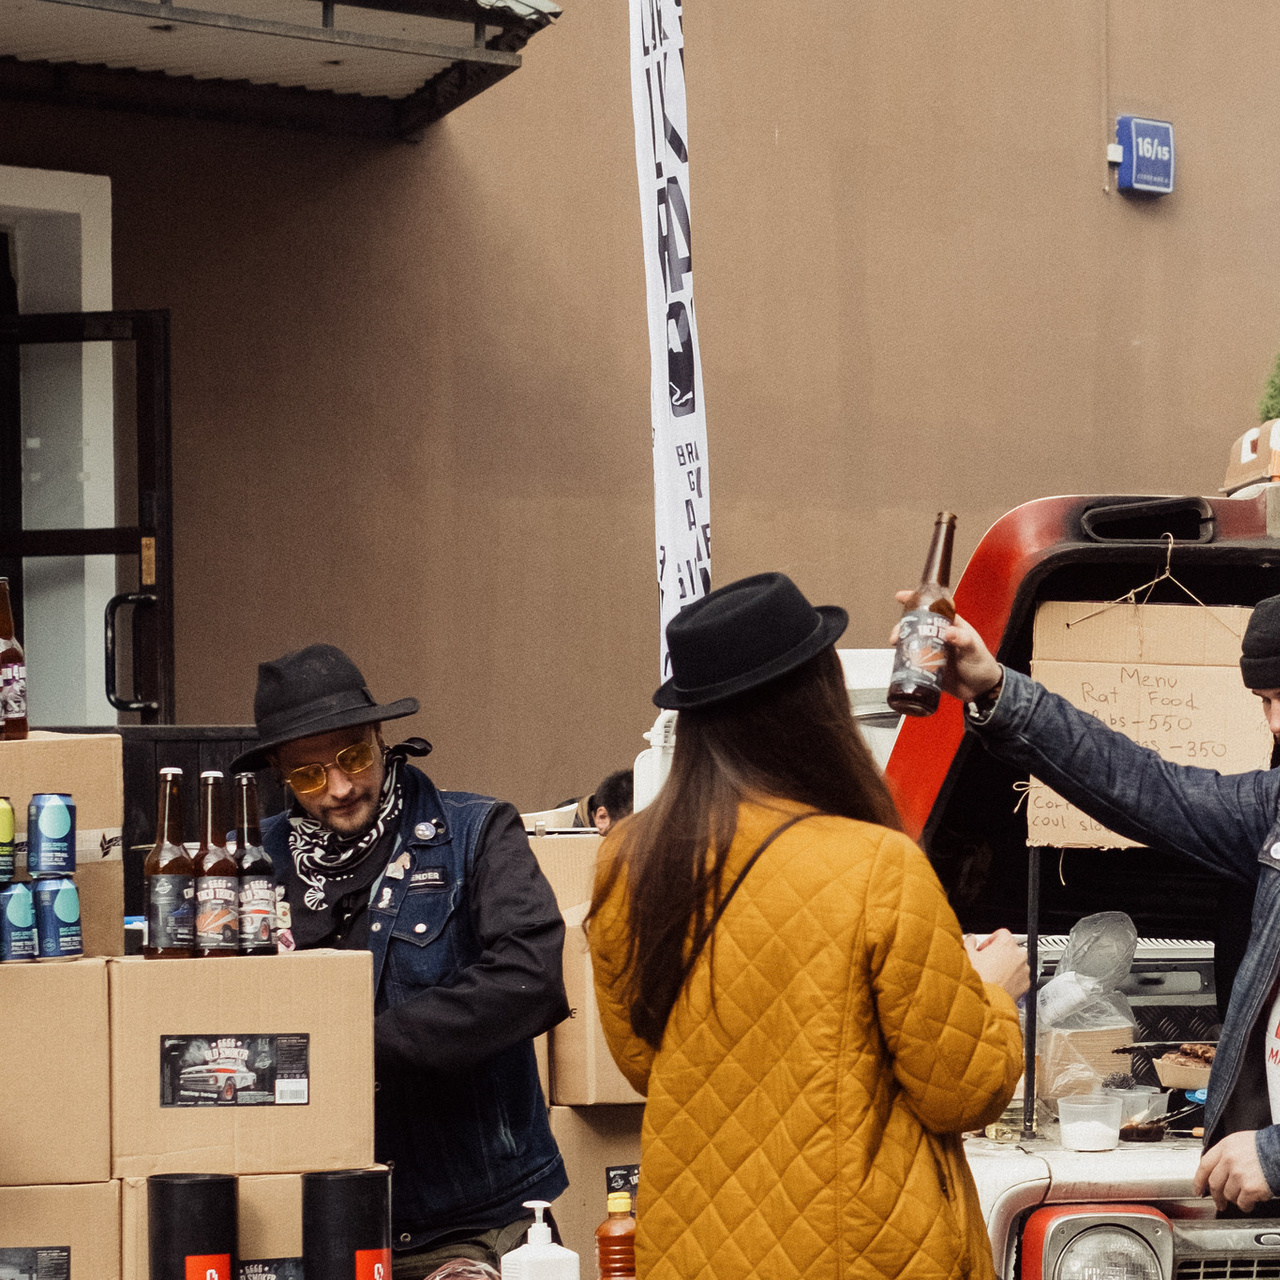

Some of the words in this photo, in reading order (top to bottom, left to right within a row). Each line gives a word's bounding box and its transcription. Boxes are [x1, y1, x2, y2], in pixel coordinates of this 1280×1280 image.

[1137, 137, 1170, 161] 16/15
[1120, 667, 1178, 689] Menu
[1081, 682, 1119, 704] Rat
[1148, 691, 1199, 710] Food
